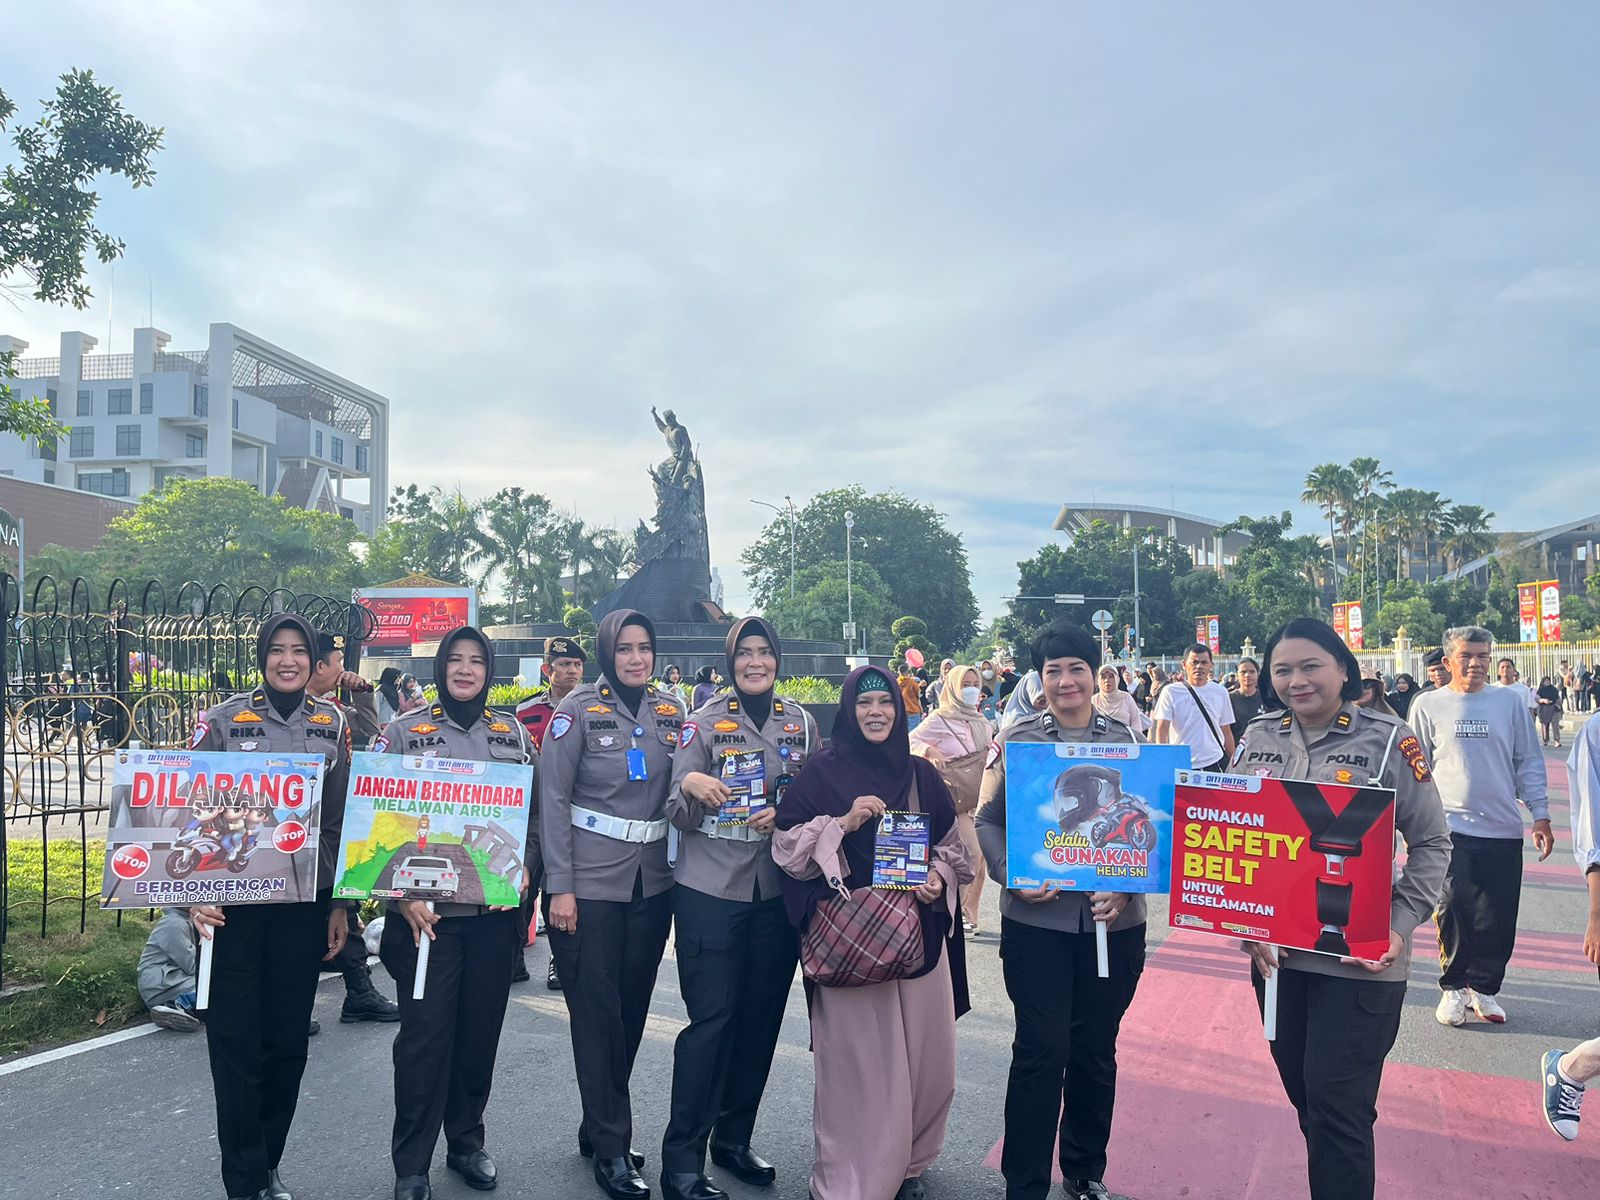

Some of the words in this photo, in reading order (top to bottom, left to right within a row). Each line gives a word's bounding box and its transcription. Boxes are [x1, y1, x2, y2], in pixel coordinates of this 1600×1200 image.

[230, 727, 266, 738] RIKA
[713, 734, 747, 744] RATNA
[408, 736, 447, 749] RIZA
[739, 758, 762, 769] SIGNAL
[1248, 752, 1283, 764] PITA
[1325, 754, 1370, 768] POLRI
[130, 771, 304, 809] DILARANG
[353, 775, 418, 799] JANGAN
[420, 780, 525, 807] BERKENDARA
[373, 797, 454, 815] MELAWAN
[459, 804, 502, 818] ARUS
[1186, 806, 1265, 828] GUNAKAN
[896, 822, 926, 830] SIGNAL
[275, 829, 305, 844] STOP
[1043, 830, 1090, 849] Selalu
[1183, 822, 1305, 861] SAFETY
[115, 853, 147, 869] STOP
[1050, 846, 1148, 866] GUNAKAN
[1096, 866, 1127, 877] HELM
[1130, 867, 1148, 877] SNI
[1183, 852, 1260, 885] BELT
[135, 878, 286, 895] BERBONCENGAN
[1182, 880, 1225, 895] UNTUK
[149, 892, 186, 903] LEBIH
[188, 891, 217, 902] DARI
[226, 890, 271, 901] ORANG
[1182, 892, 1274, 916] KESELAMATAN
